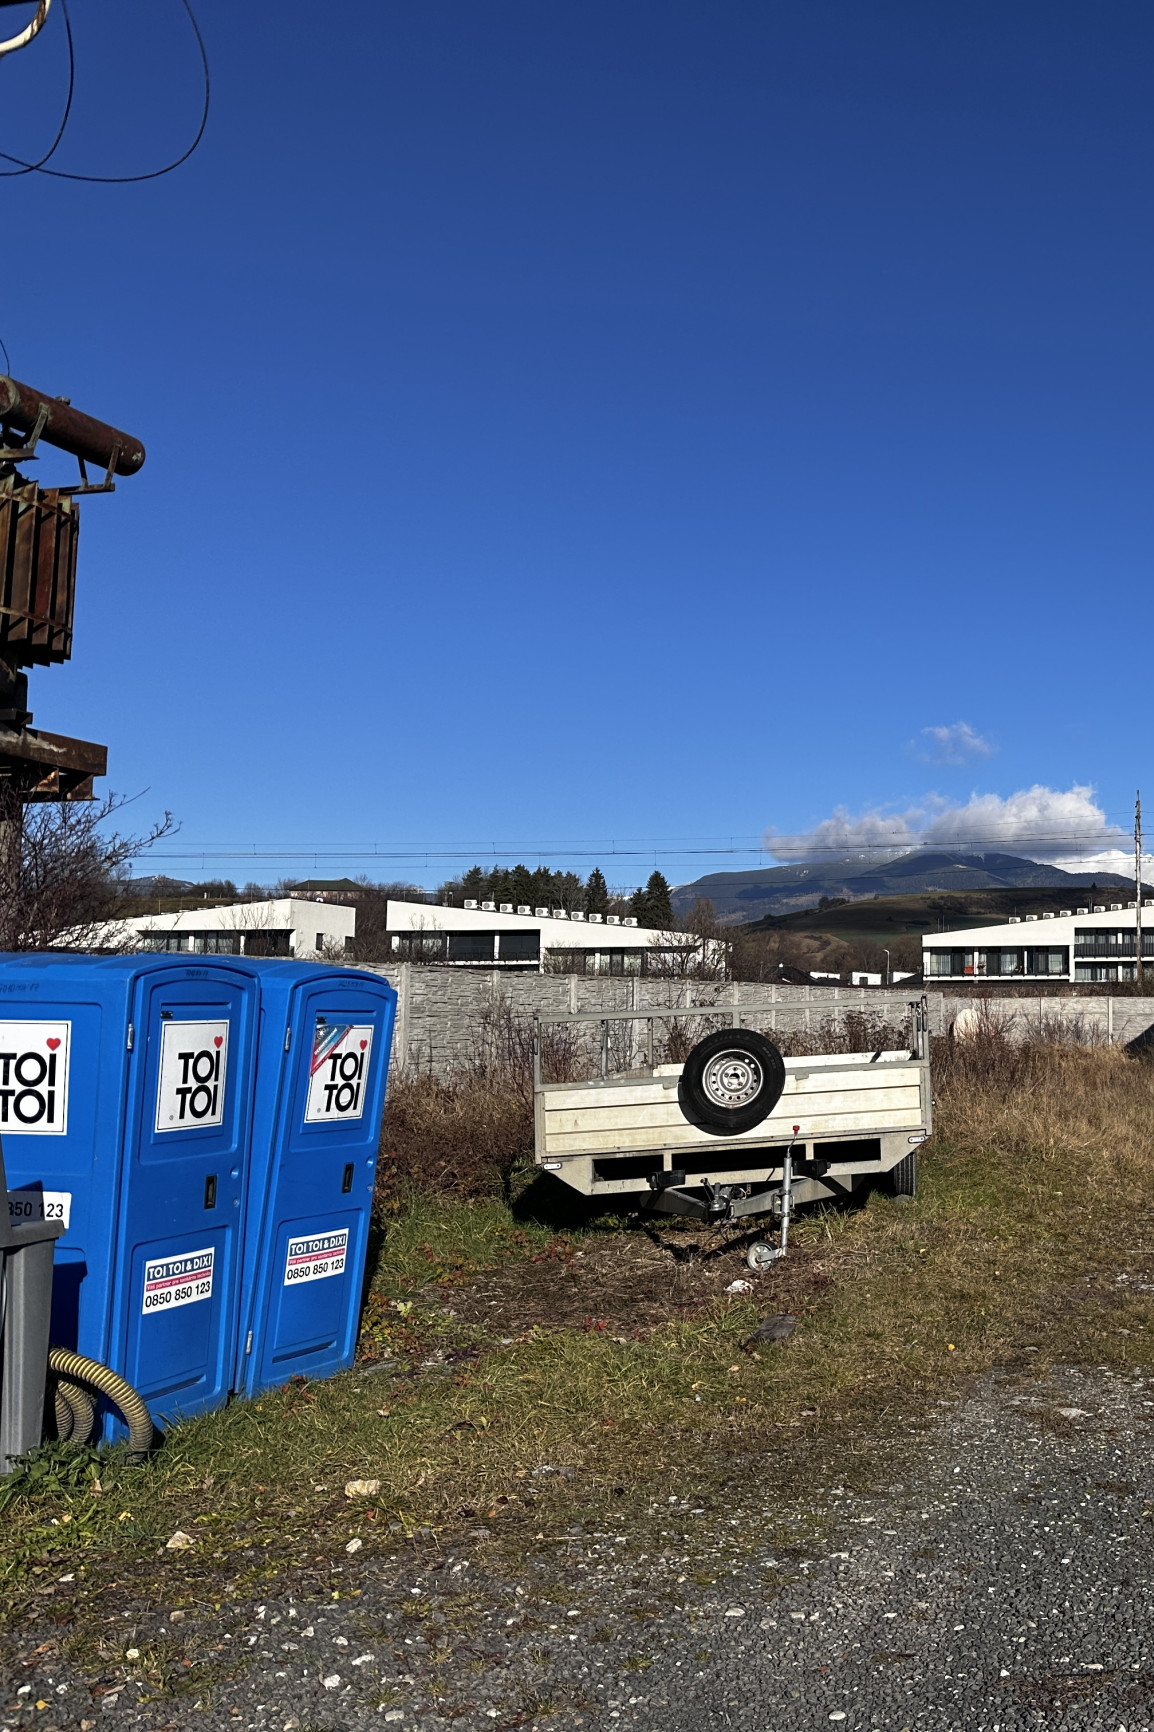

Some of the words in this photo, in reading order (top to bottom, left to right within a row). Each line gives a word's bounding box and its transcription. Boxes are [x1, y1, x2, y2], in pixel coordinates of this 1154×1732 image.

[0, 1052, 57, 1088] TOI
[178, 1050, 221, 1084] TOI
[328, 1051, 365, 1082] TOI
[0, 1088, 55, 1124] TOI
[175, 1084, 219, 1120] TOI
[323, 1082, 361, 1113] TOI
[38, 1202, 64, 1218] 123
[291, 1243, 306, 1254] TOI
[309, 1240, 322, 1251] TOI
[324, 1240, 329, 1248] &
[330, 1236, 345, 1247] DIXI
[149, 1266, 166, 1279] TOI
[169, 1262, 184, 1275] TOI
[186, 1261, 192, 1270] &
[194, 1255, 211, 1269] DIXI
[287, 1266, 310, 1280] 0850
[313, 1262, 328, 1274] 850
[331, 1258, 344, 1270] 123
[145, 1291, 171, 1307] 0850
[175, 1286, 192, 1300] 850
[195, 1281, 210, 1295] 123
